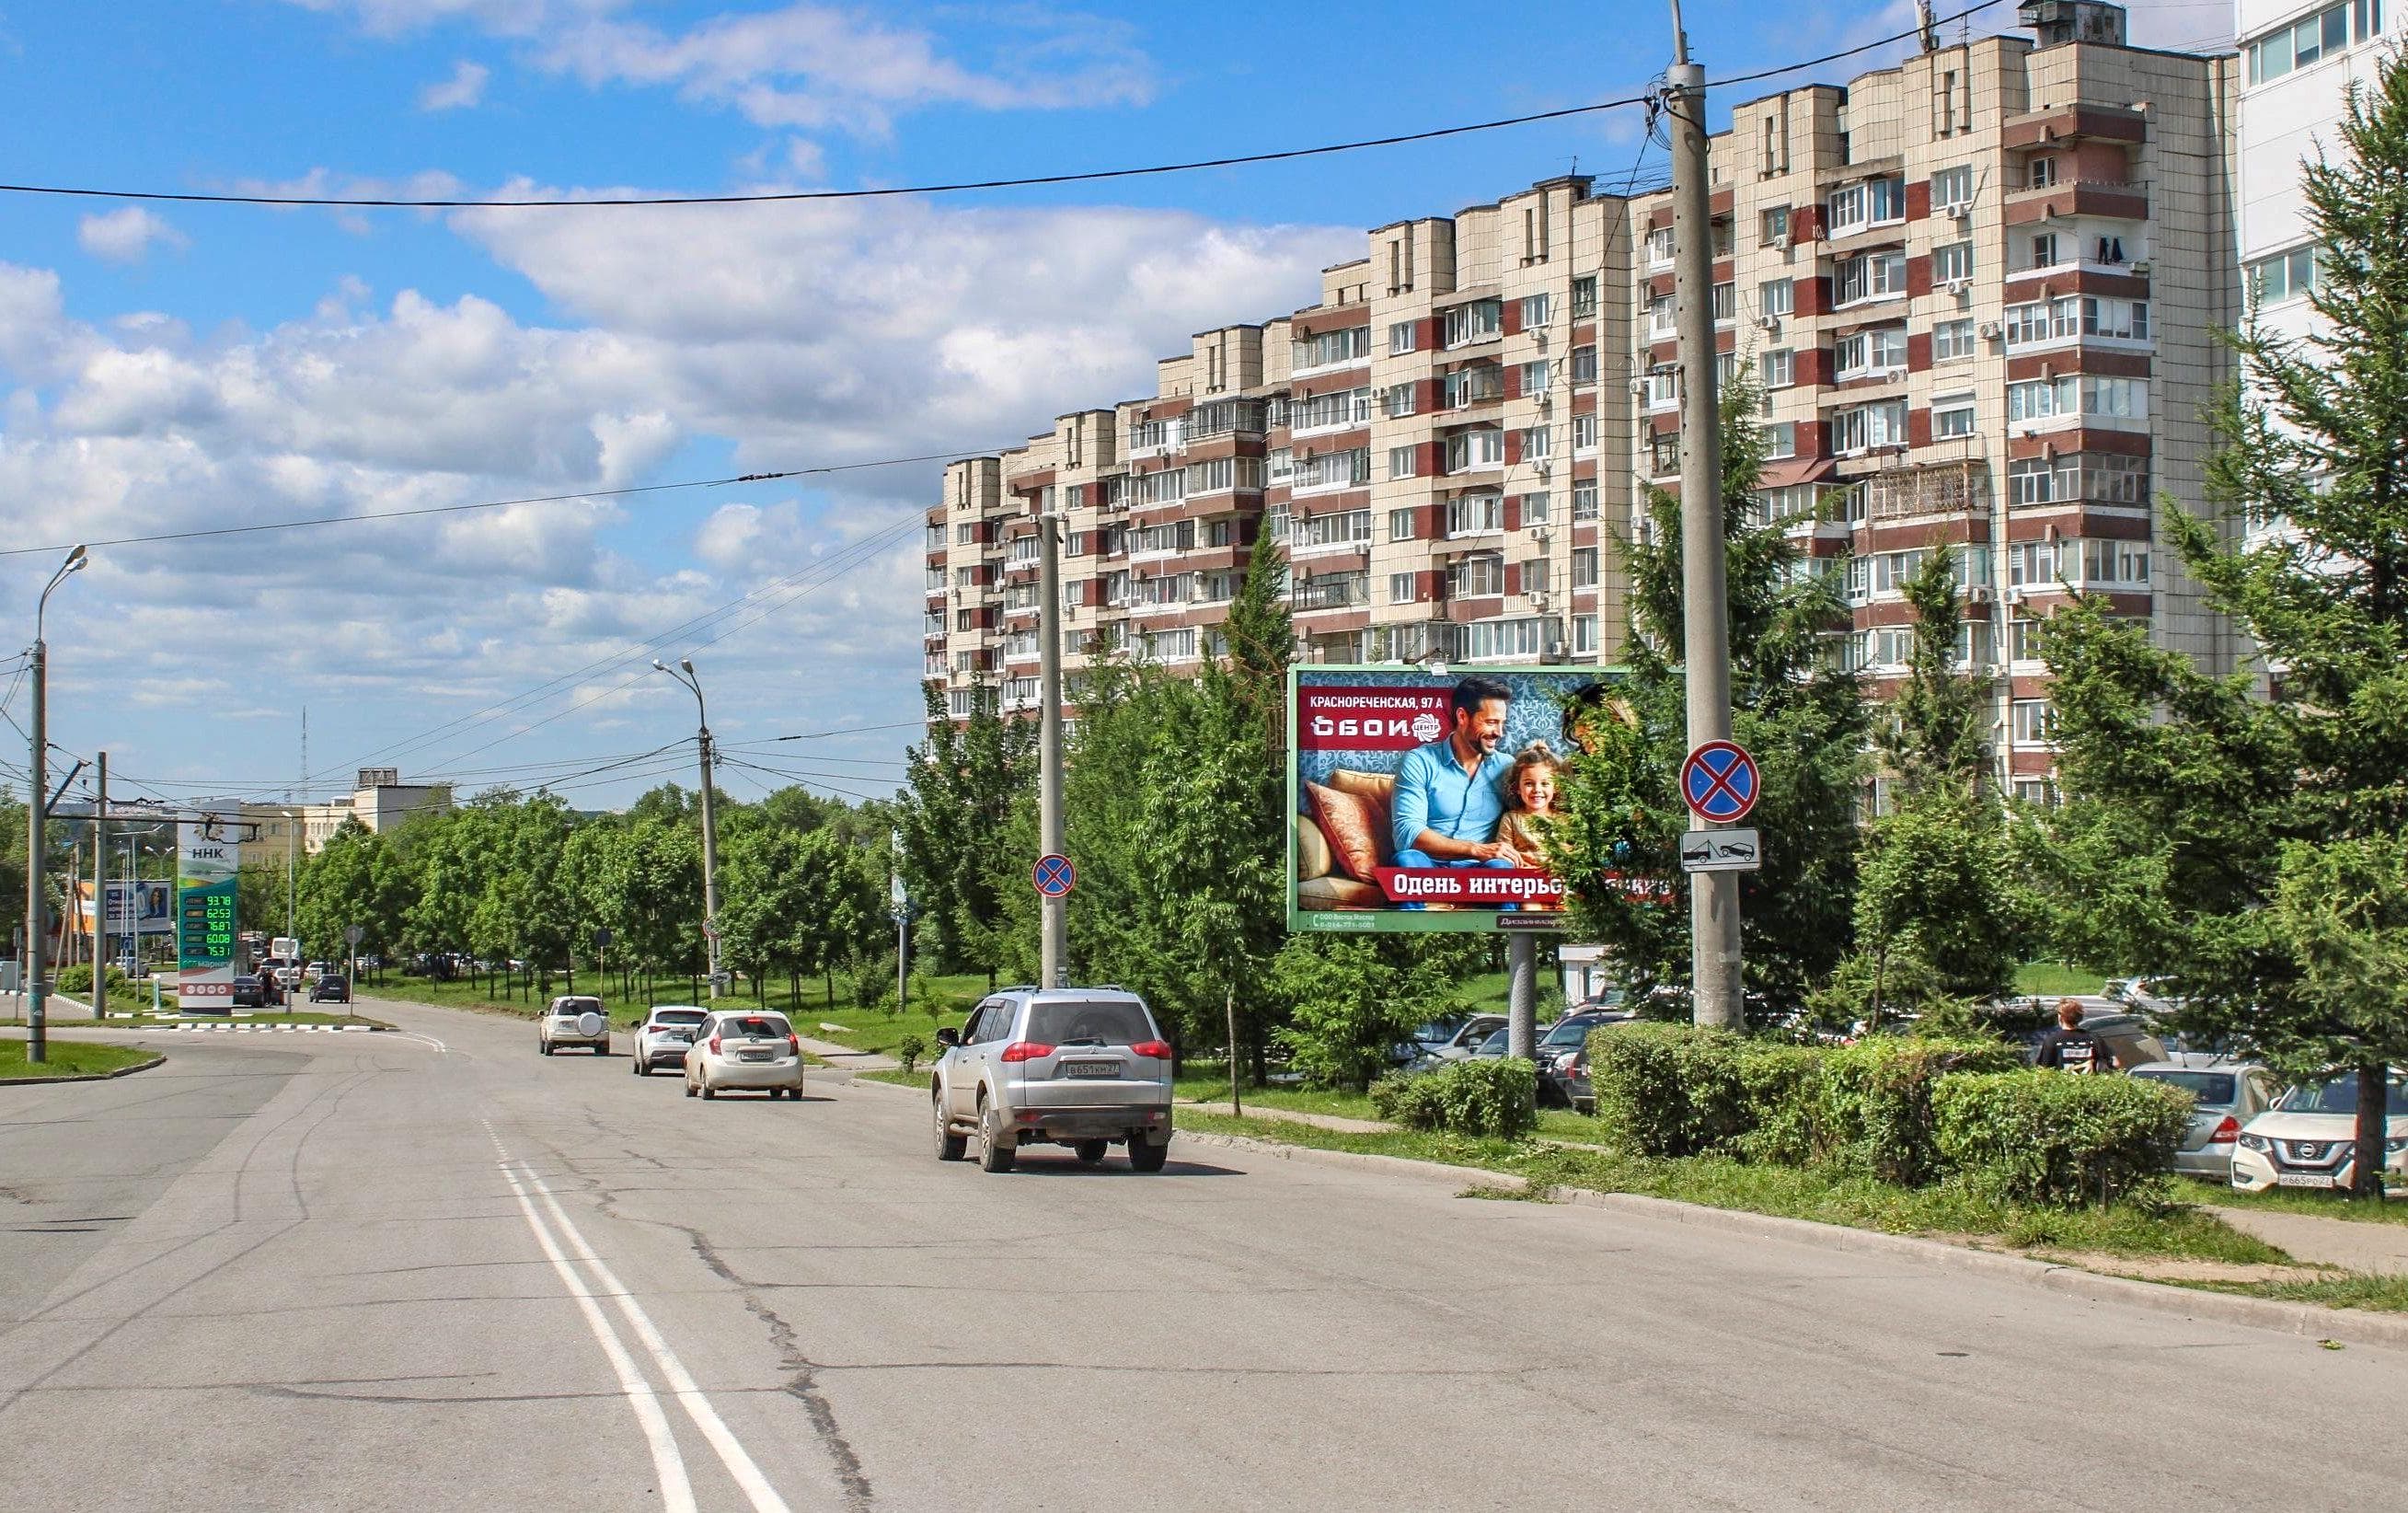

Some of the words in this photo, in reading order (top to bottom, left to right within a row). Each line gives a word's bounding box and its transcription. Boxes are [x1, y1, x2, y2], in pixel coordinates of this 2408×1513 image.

[1310, 697, 1419, 710] КРАСНОРЕЧЕНСКАЯ,
[1421, 697, 1434, 708] 97
[1435, 697, 1444, 708] А
[1310, 716, 1411, 736] ОБОИ
[192, 849, 224, 859] ННК
[1394, 873, 1462, 895] Одень
